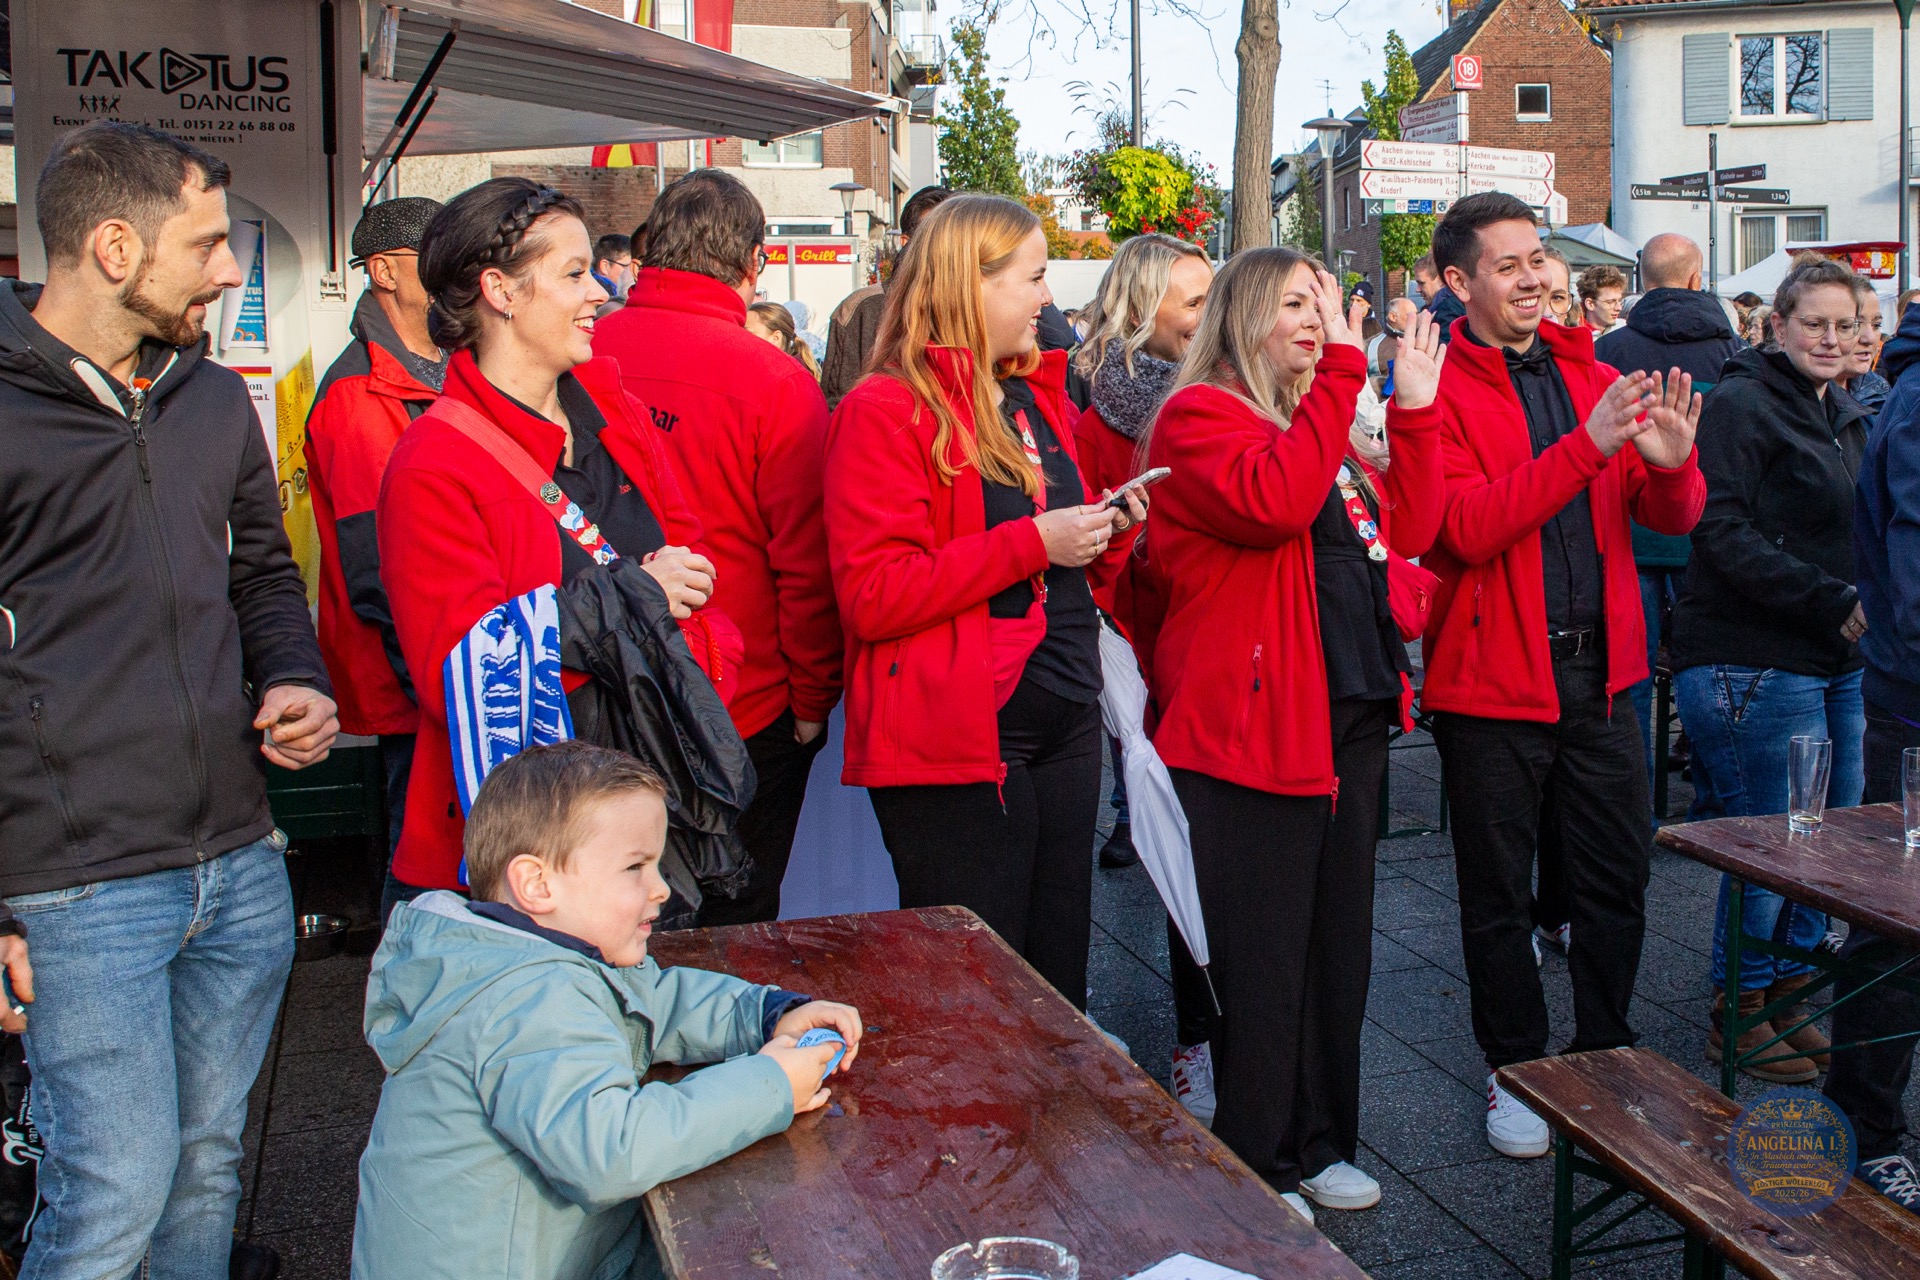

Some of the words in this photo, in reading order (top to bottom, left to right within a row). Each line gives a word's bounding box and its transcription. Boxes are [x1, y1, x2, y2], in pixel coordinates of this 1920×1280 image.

[1462, 62, 1474, 76] 18
[180, 93, 291, 113] DANCING
[183, 119, 213, 130] 0151
[218, 120, 234, 131] 22
[239, 121, 254, 131] 66
[259, 122, 275, 132] 88
[279, 122, 295, 132] 08
[1381, 146, 1403, 154] Aachen
[1470, 151, 1491, 160] Aachen
[1470, 163, 1496, 171] Kerkrade
[1393, 174, 1443, 186] Übach-Palenberg
[1470, 178, 1496, 187] Würselen
[1380, 187, 1402, 195] Alsdorf
[1643, 188, 1652, 196] km
[1681, 189, 1701, 197] Bahnhof
[1396, 202, 1406, 210] R9
